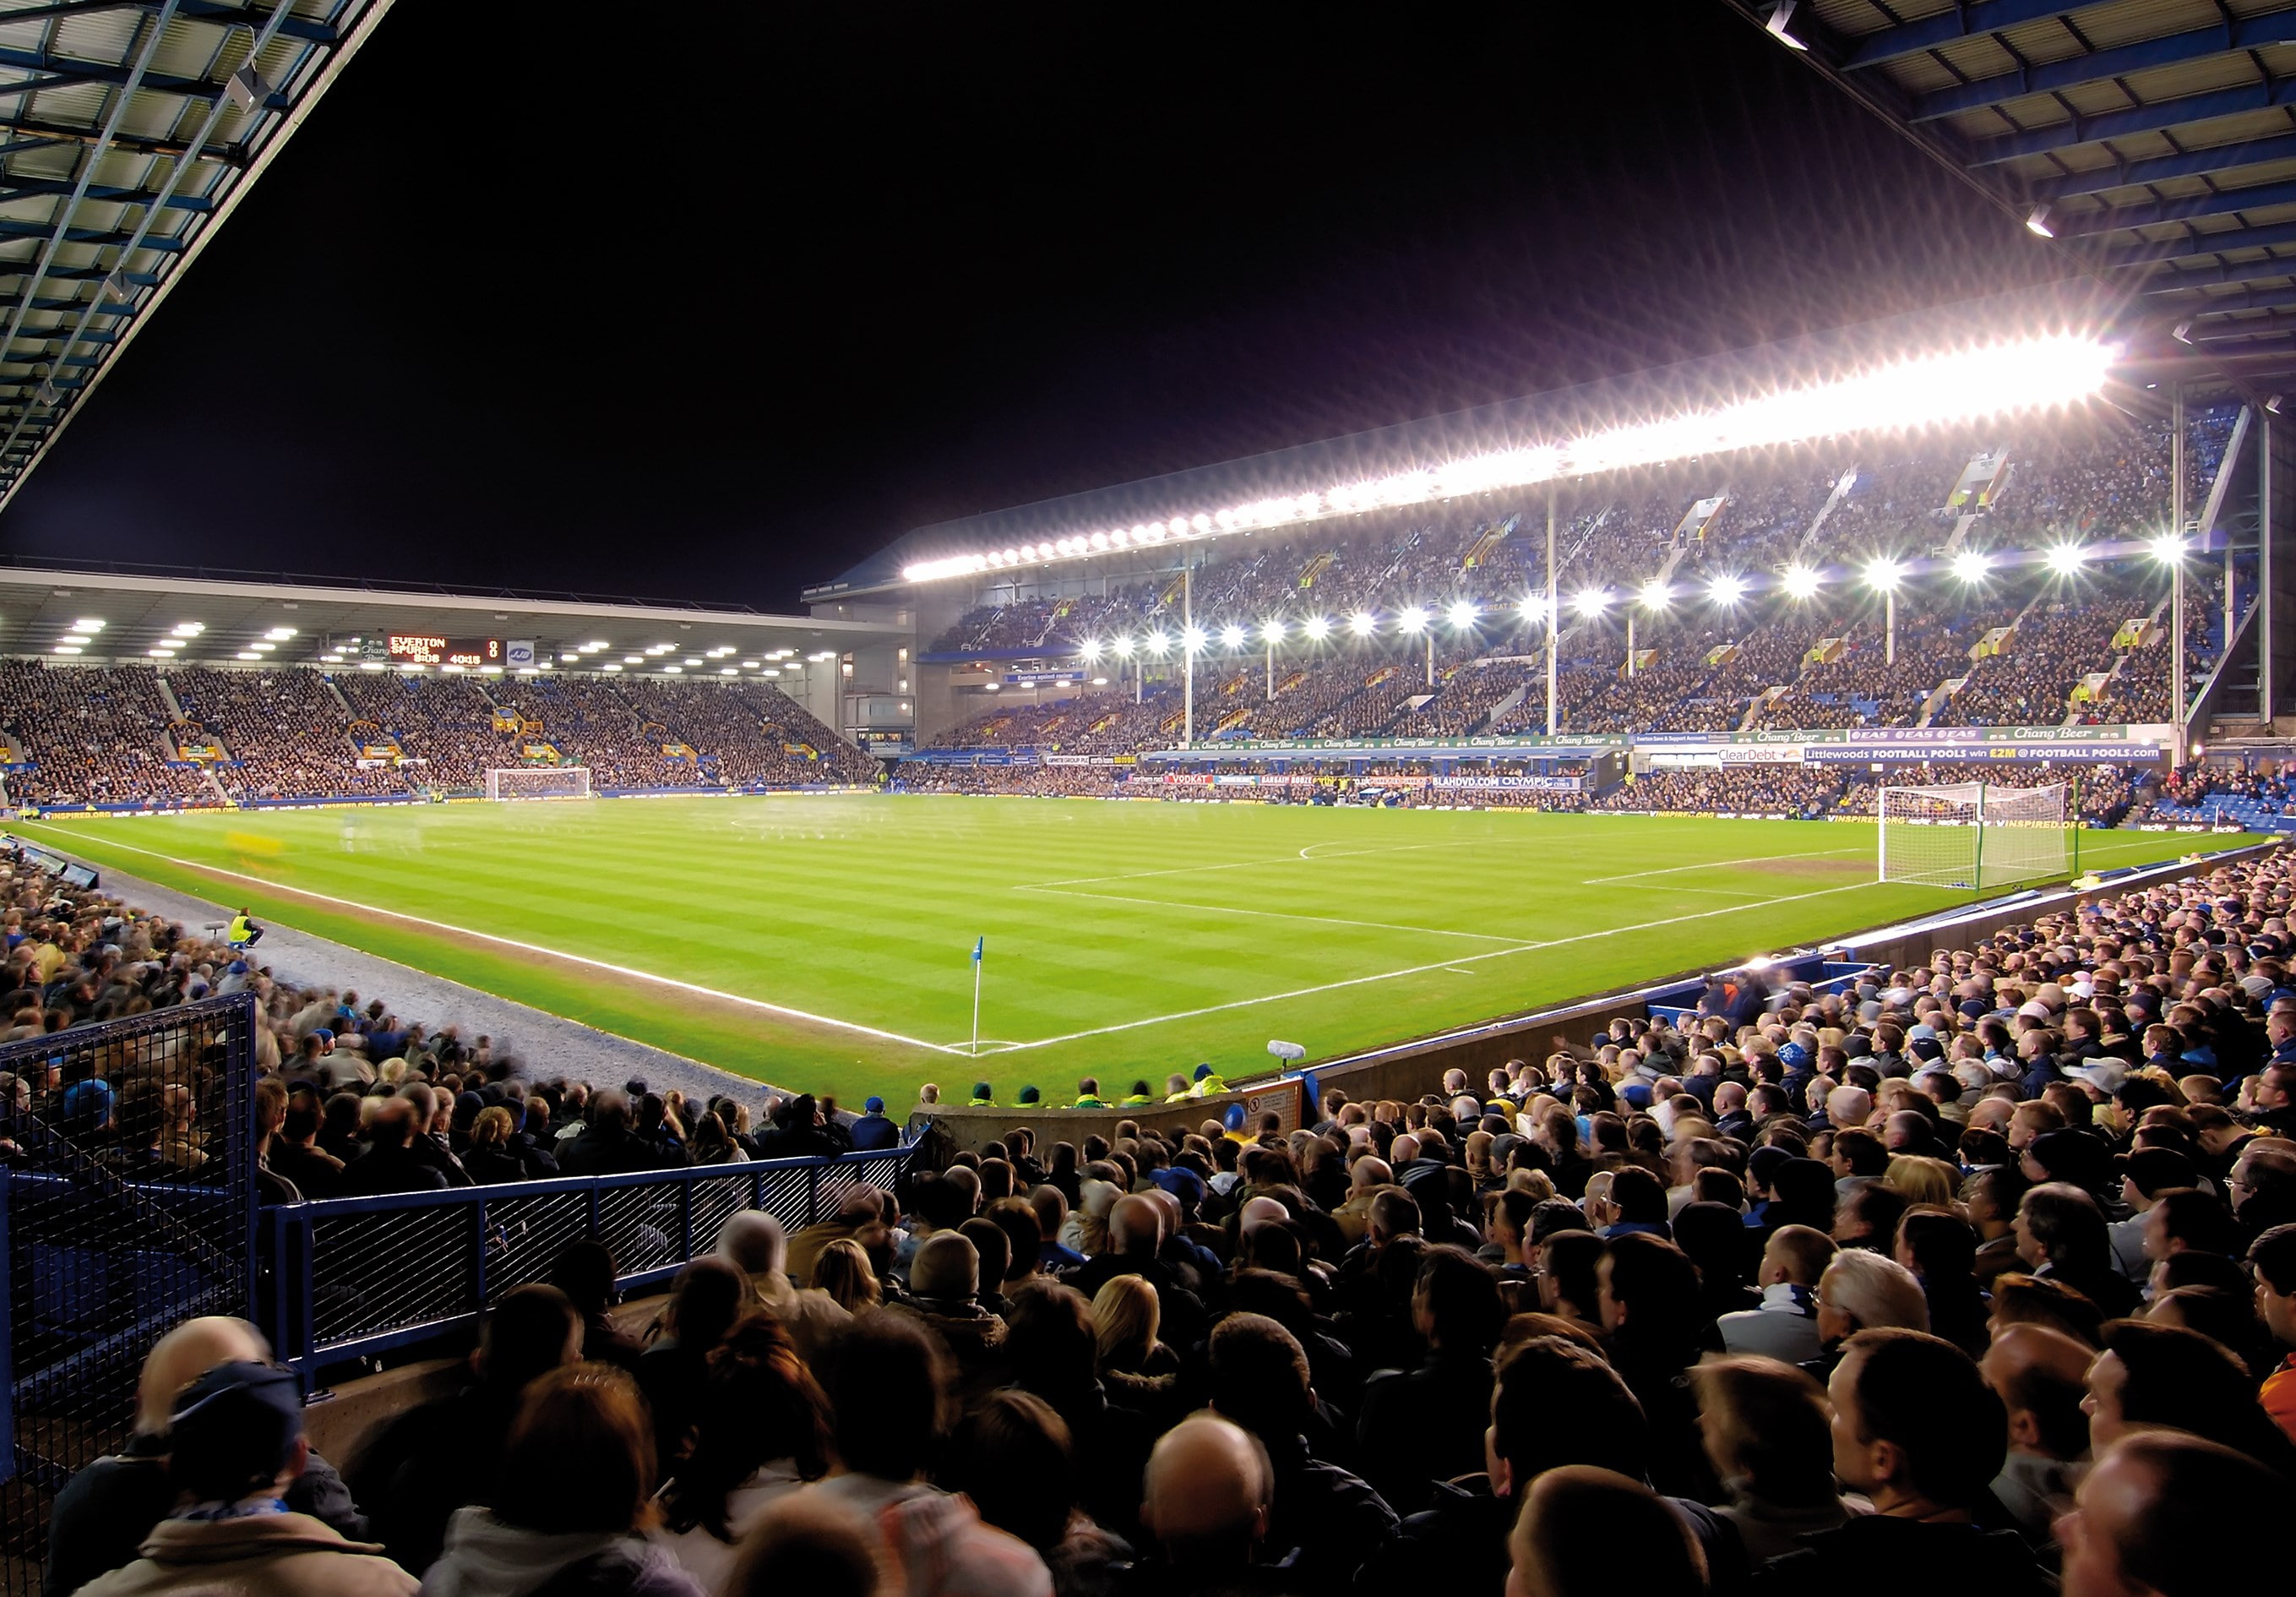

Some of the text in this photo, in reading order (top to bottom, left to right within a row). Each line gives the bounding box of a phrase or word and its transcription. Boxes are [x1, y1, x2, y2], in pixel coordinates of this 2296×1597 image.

[391, 636, 498, 650] EVERTON 0
[362, 646, 389, 657] Chang
[391, 646, 498, 657] SPURS 0
[1757, 732, 1819, 743] Chang Beer
[2014, 728, 2092, 740] Chang Beer
[1260, 740, 1294, 749] Chang Beer
[1324, 739, 1362, 749] Chang Beer
[1394, 738, 1434, 748] Chang Beer
[1471, 737, 1516, 747] Chang Beer
[1555, 735, 1605, 747] Chang Beer
[1718, 749, 1777, 760] ClearDebt
[1806, 749, 1869, 759] Littlewoods
[1872, 749, 1928, 758] FOOTBALL
[1930, 749, 1966, 758] POOLS
[1989, 748, 2016, 758] £2M
[2030, 749, 2088, 758] FOOTBALL
[2092, 749, 2158, 758] POOLS.com
[1172, 775, 1207, 783] VODKAT
[1291, 776, 1312, 784] BOOZE
[1433, 777, 1499, 787] BLAHDVD.COM
[1502, 777, 1553, 788] OLYMPIC
[1827, 815, 1906, 824] VINSPIREDORG
